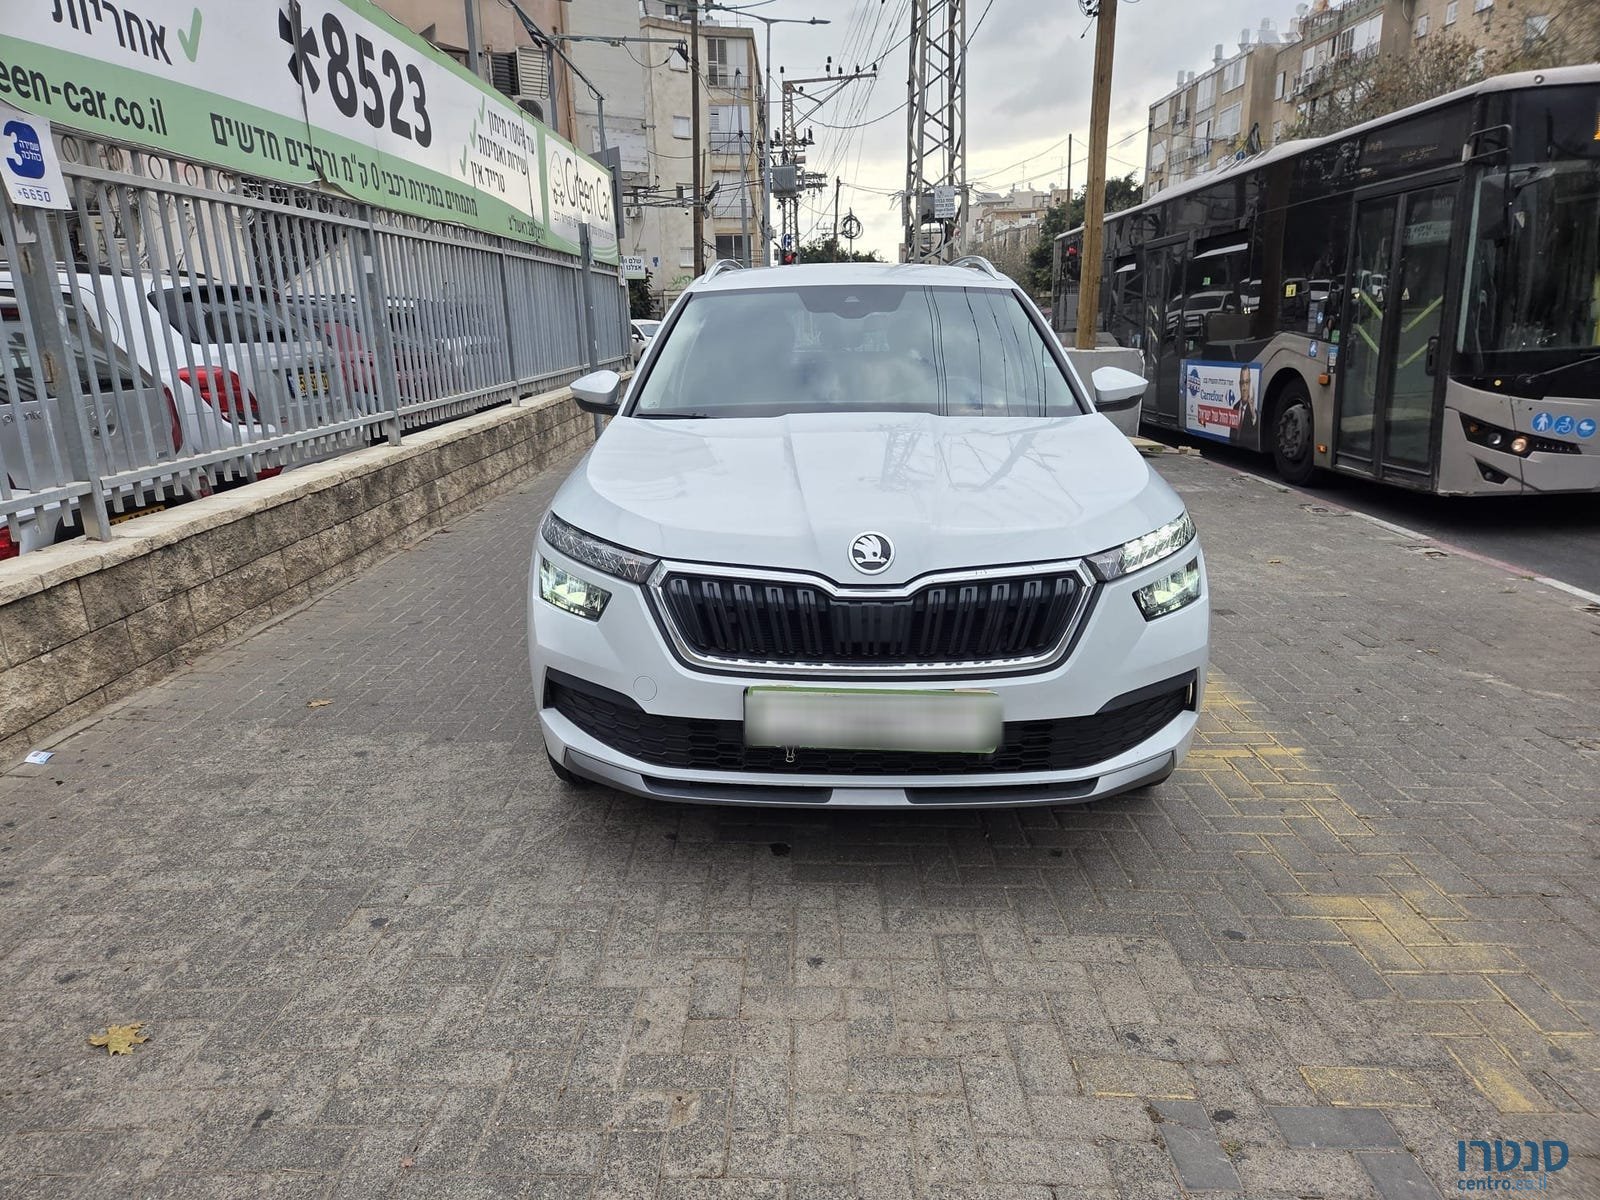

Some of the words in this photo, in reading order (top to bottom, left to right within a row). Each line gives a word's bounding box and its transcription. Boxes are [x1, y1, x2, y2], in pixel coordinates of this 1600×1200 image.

[487, 109, 507, 136] מימון
[209, 112, 282, 162] חדשים
[20, 150, 42, 162] כהלכה
[381, 170, 408, 198] רכבי
[470, 160, 485, 188] אין
[408, 178, 445, 208] במכירת
[444, 189, 479, 217] מתמחים
[564, 157, 597, 216] Green
[596, 176, 610, 222] Car
[1200, 389, 1224, 402] Carrefour
